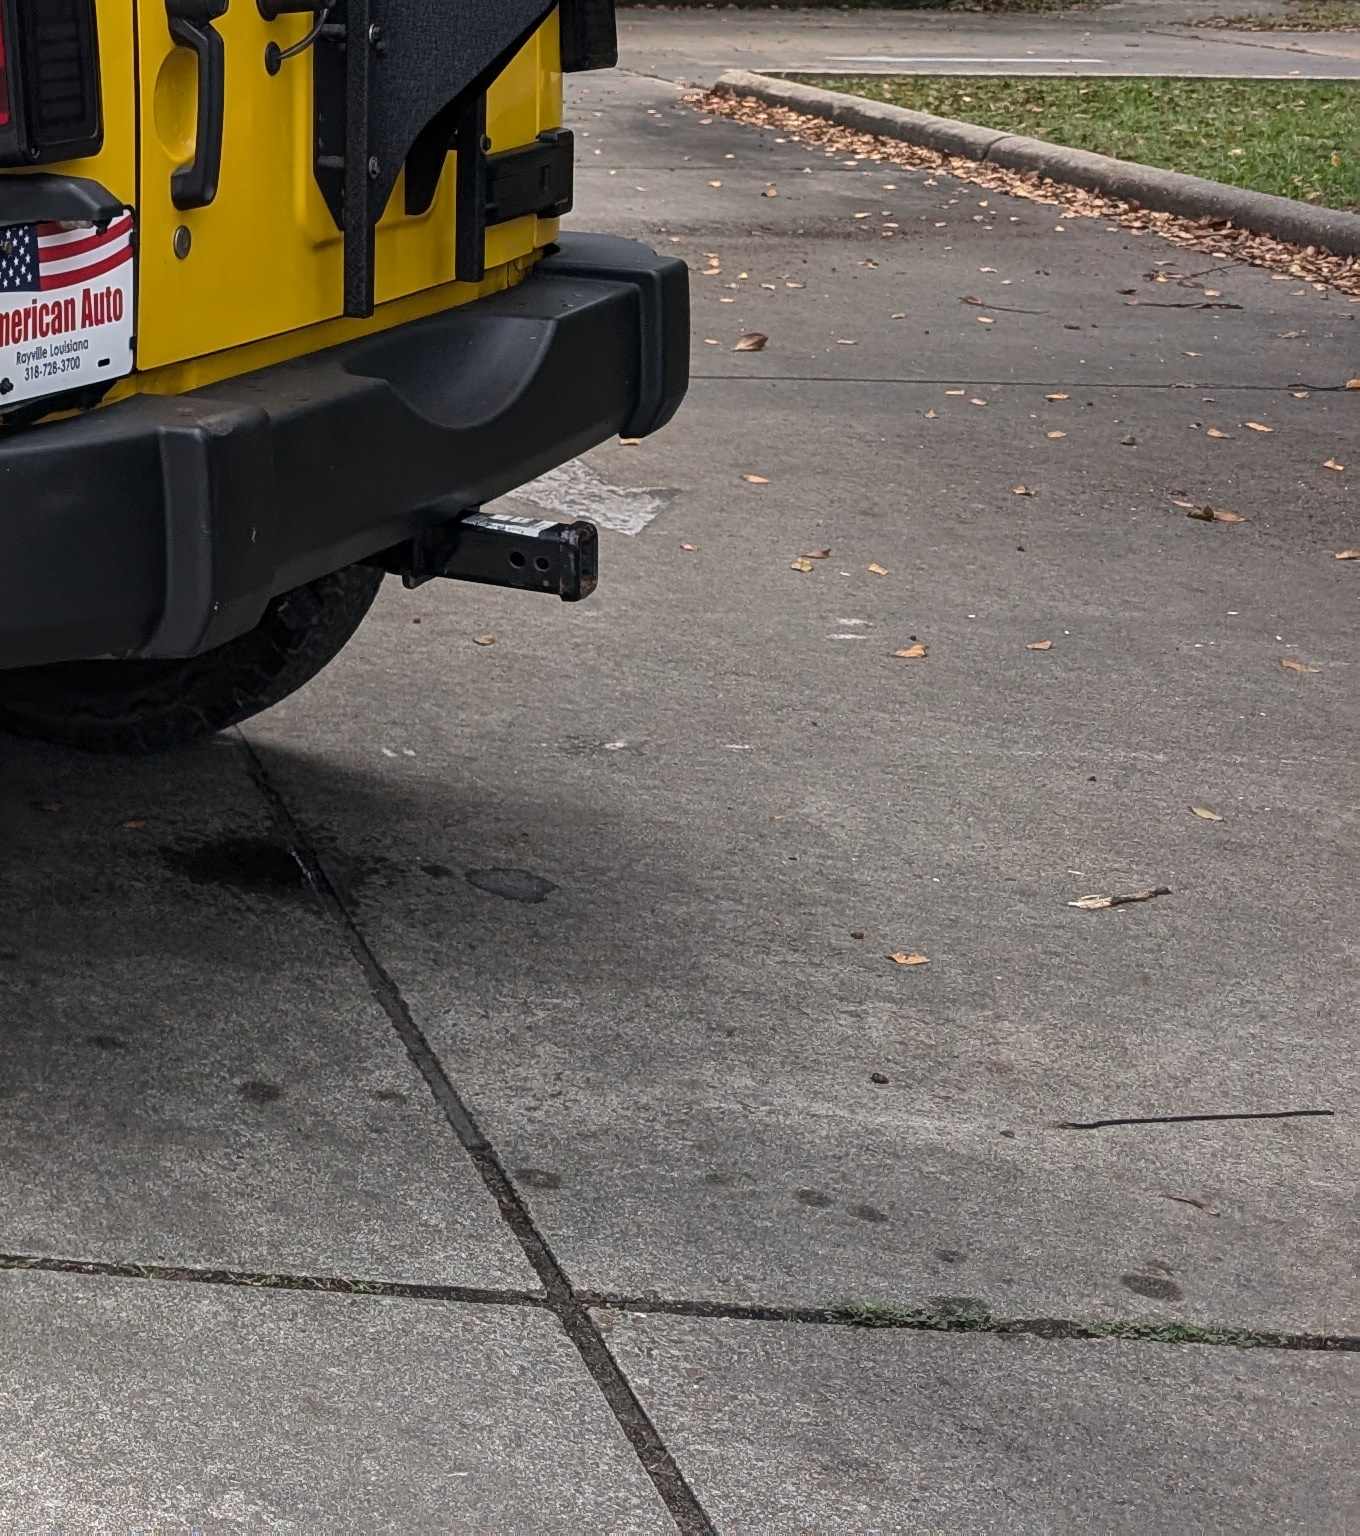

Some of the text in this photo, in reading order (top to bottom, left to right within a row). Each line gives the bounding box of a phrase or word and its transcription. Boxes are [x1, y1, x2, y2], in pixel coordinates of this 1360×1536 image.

[81, 286, 123, 329] Auto
[16, 339, 89, 366] Rayville Louisiana
[24, 356, 80, 381] 318-728-3700
